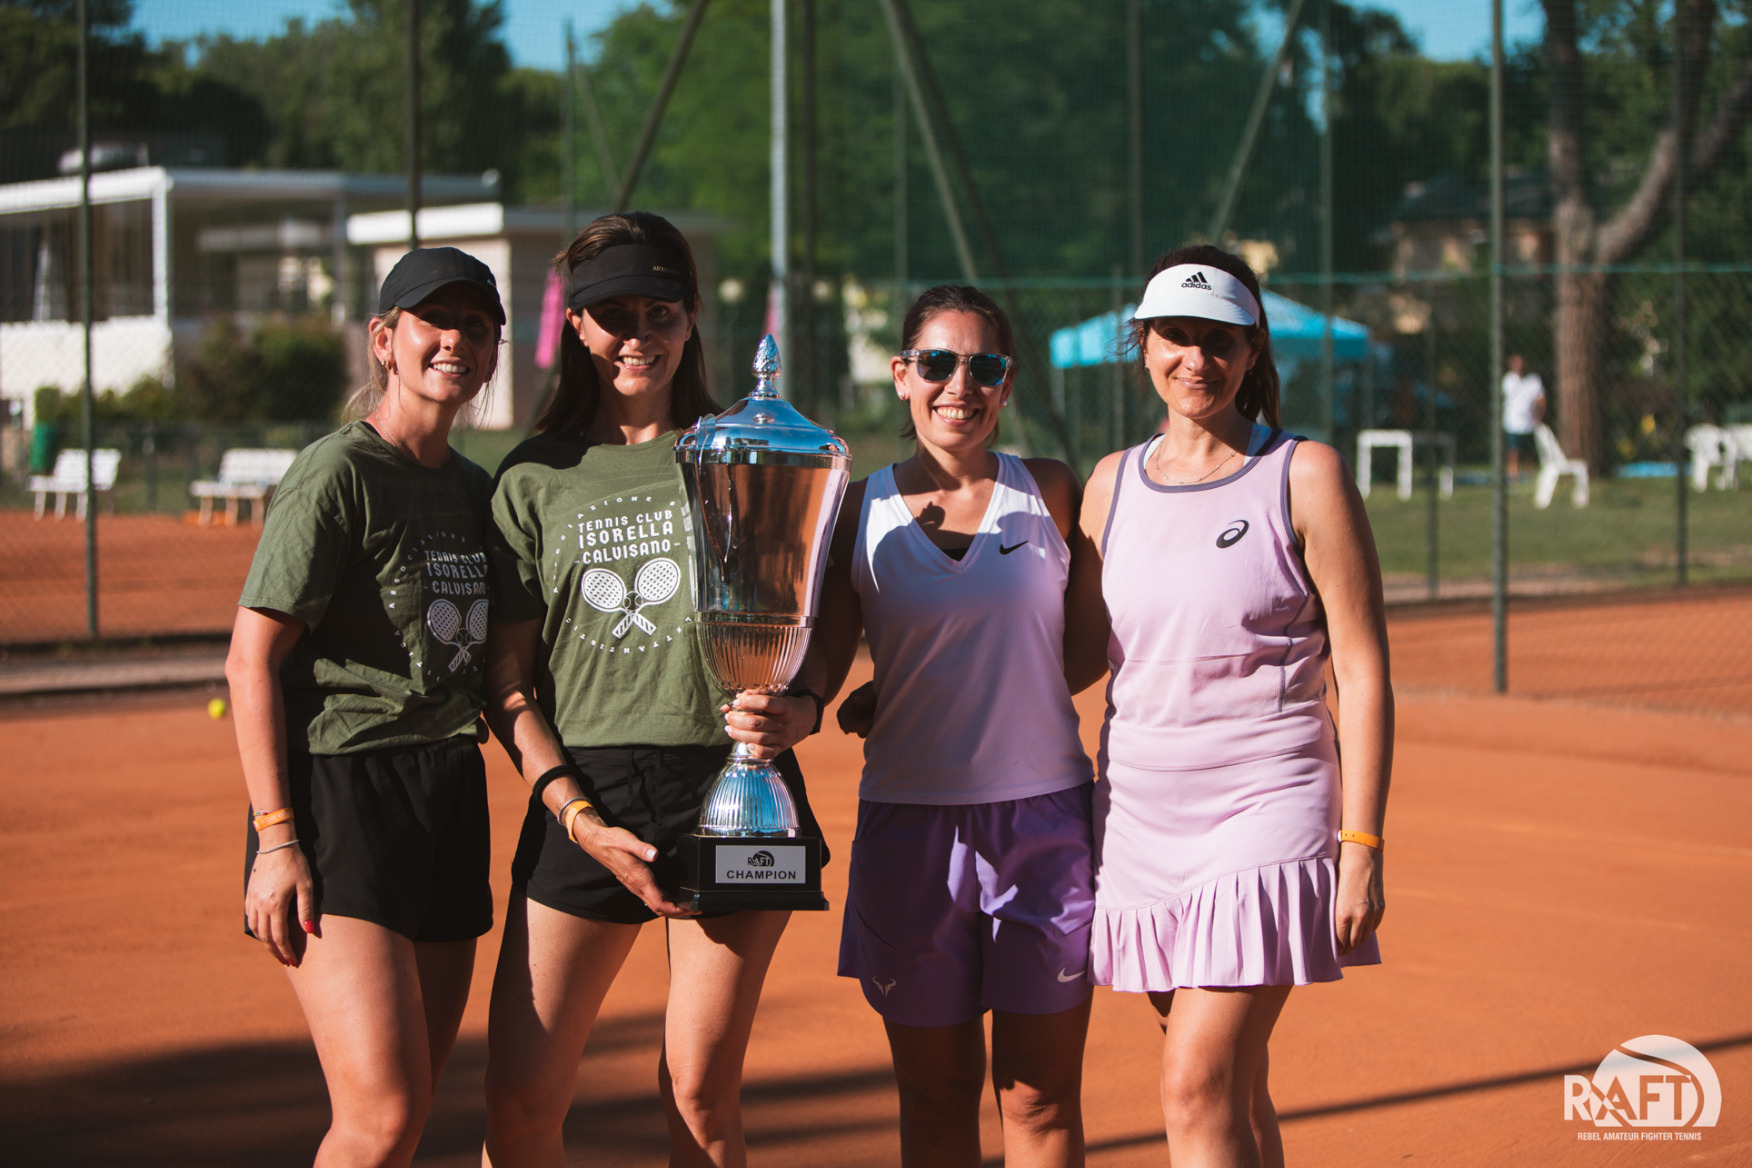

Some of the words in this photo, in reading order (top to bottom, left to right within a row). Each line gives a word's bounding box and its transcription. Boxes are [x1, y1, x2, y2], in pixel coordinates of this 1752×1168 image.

[1181, 281, 1212, 291] adidas
[578, 515, 628, 534] TENNIS
[636, 510, 673, 524] CLUB
[579, 521, 674, 549] ISORELLA
[424, 550, 458, 563] TENNIS
[460, 552, 487, 564] CLUB
[582, 539, 671, 565] CALVISANO
[432, 580, 486, 595] CALVISAN
[726, 870, 796, 880] CHAMPION
